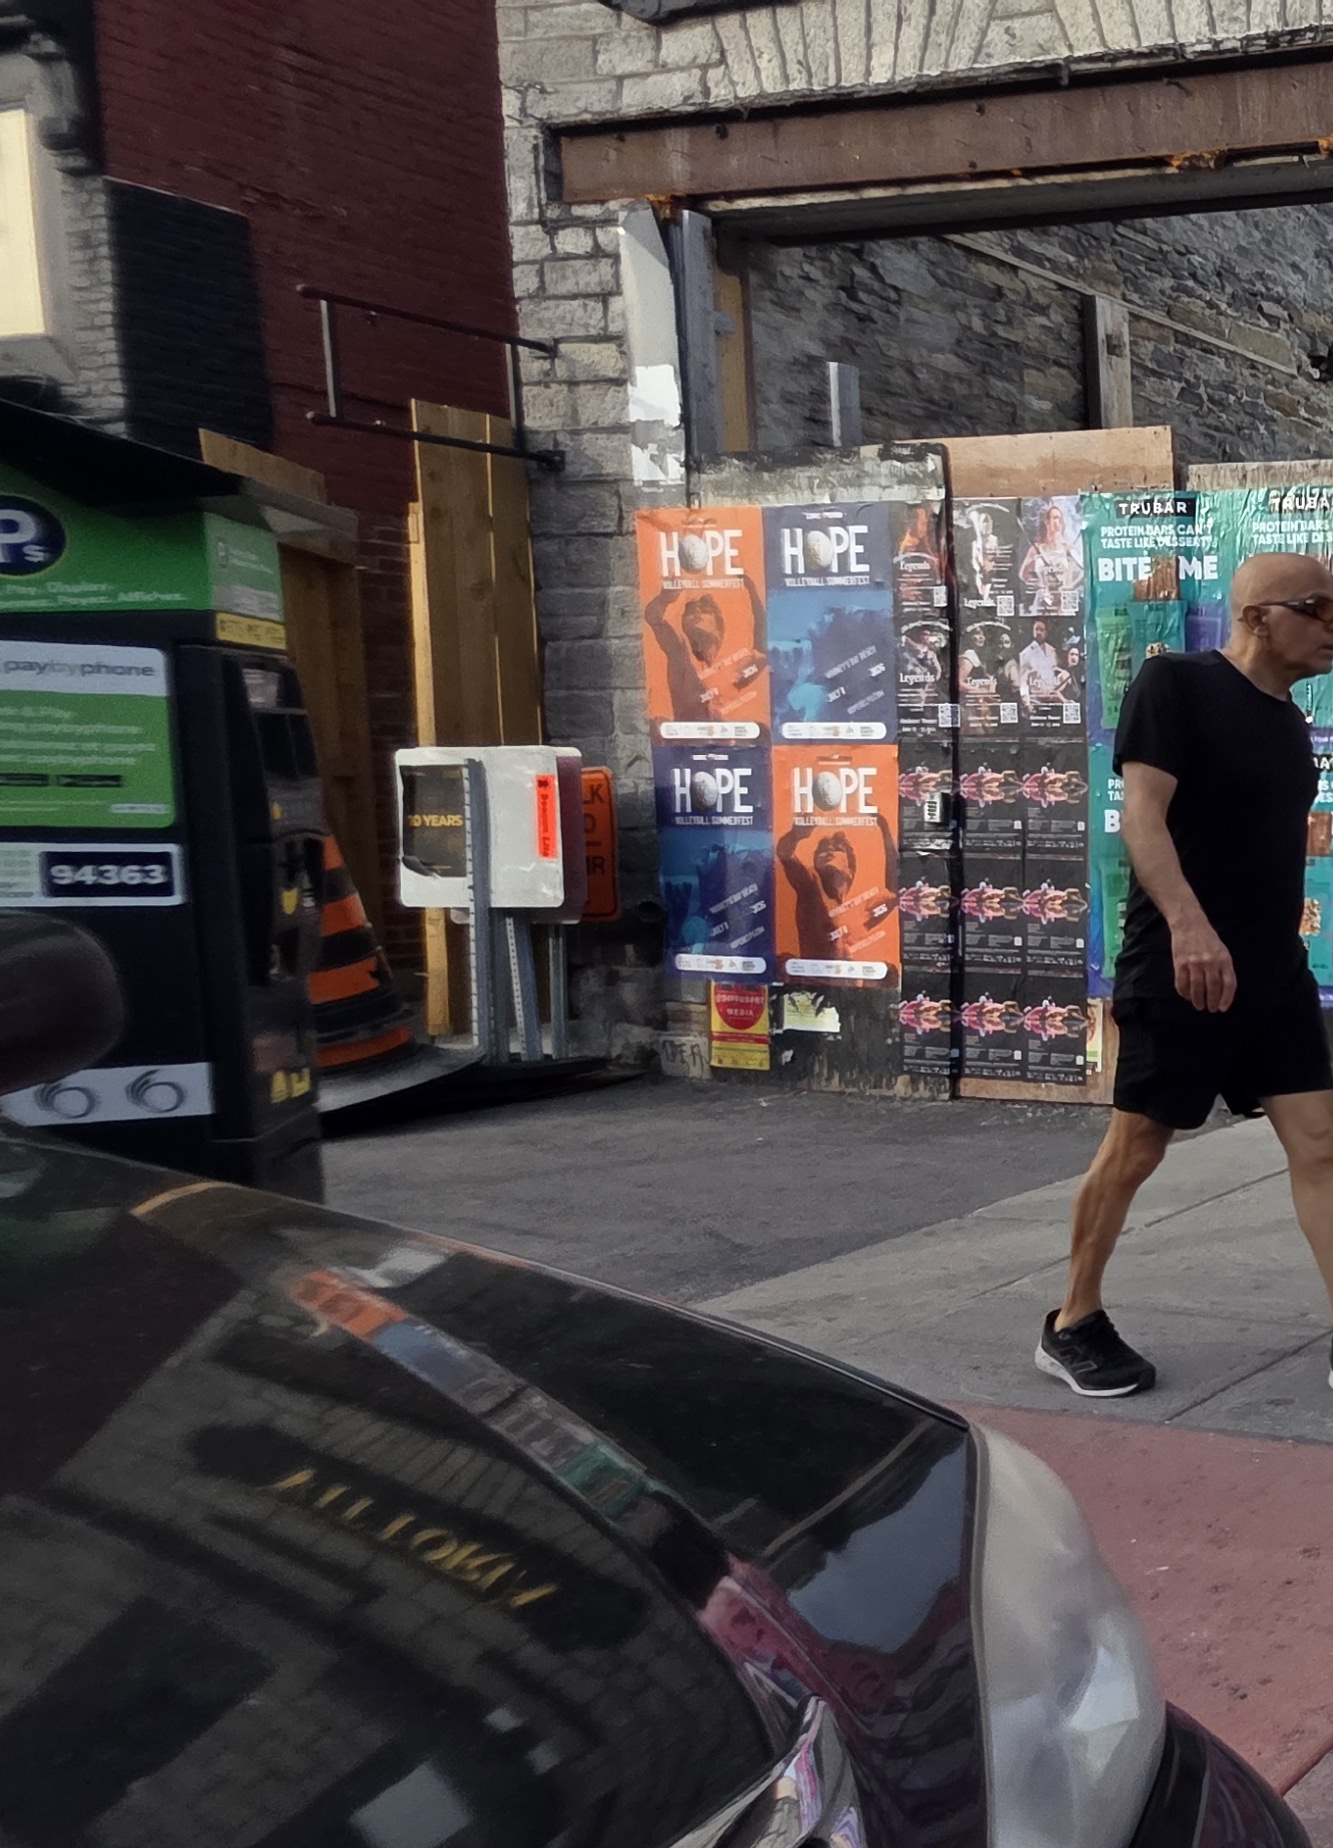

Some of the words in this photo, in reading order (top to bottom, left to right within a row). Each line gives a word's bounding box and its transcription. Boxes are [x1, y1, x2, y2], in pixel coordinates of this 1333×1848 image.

[1119, 501, 1188, 515] TRUBAR
[1101, 525, 1145, 538] PROTEIN
[1253, 520, 1300, 534] PROTEIN
[1102, 537, 1132, 549] TASTE
[1253, 533, 1284, 546] TASTE
[1286, 532, 1309, 545] LIKE
[660, 530, 745, 577] HOPE
[782, 525, 870, 575] HOPE
[1099, 555, 1153, 582] BITE
[1179, 555, 1219, 581] ME
[785, 576, 825, 587] VOLLEYBALL
[827, 575, 870, 586] SUMMERFEST
[4, 660, 155, 677] paybyphone
[674, 768, 754, 814] HOPE
[793, 767, 878, 814] HOPE
[424, 815, 463, 827] YEARS
[675, 816, 710, 826] VOLLEYBALL
[711, 816, 753, 826] SUMMERFEST
[795, 816, 833, 826] VOLLEYBALL
[834, 816, 877, 827] SUMMERFEST
[50, 864, 167, 885] 94363
[727, 1008, 753, 1017] MEDIA
